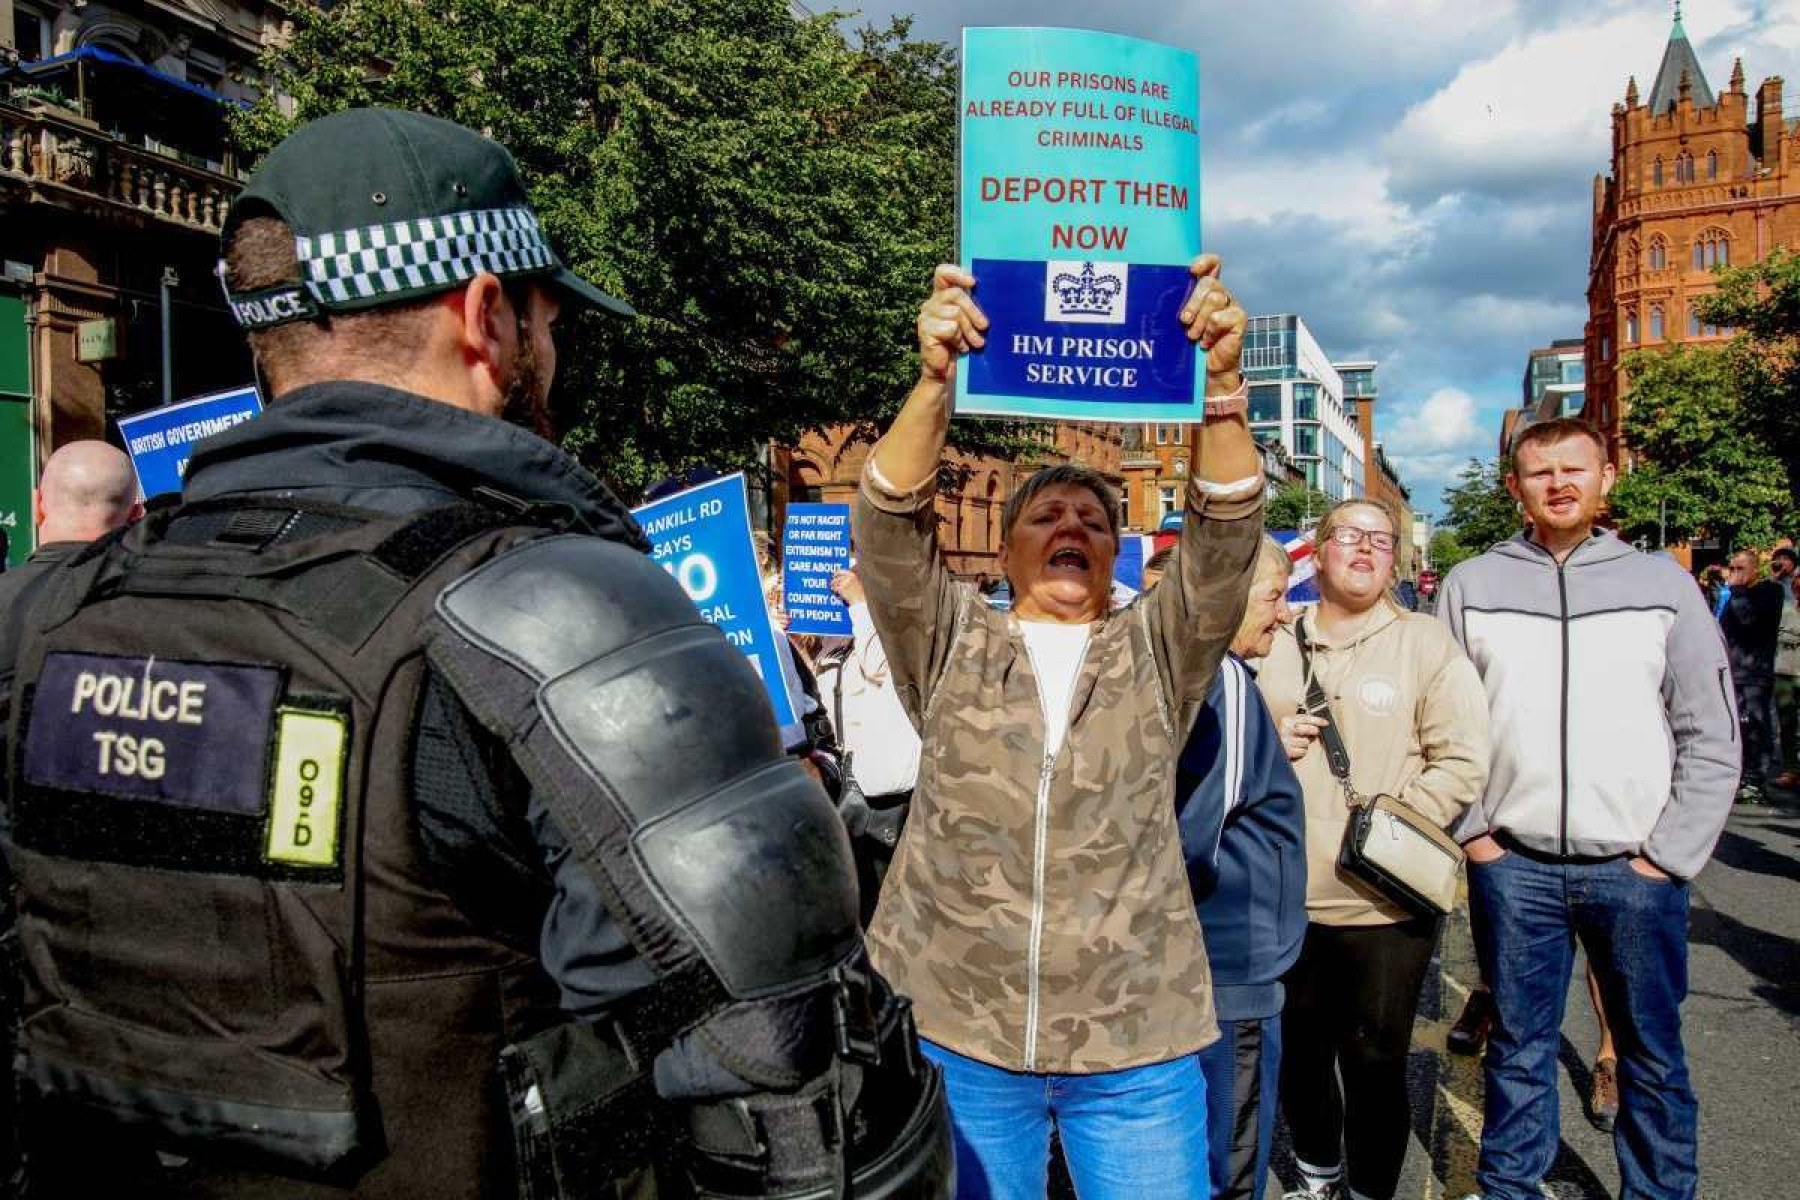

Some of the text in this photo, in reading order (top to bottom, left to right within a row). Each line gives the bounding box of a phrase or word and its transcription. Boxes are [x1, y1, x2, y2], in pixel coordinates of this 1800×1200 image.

[1008, 71, 1169, 99] OUR PRISONS ARE
[965, 100, 1199, 135] ALREADY FULL OF ILLEGAL
[1037, 131, 1144, 151] CRIMINALS
[980, 177, 1189, 211] DEPORT THEM
[1051, 224, 1129, 250] NOW
[232, 291, 308, 325] POLICE
[1012, 335, 1155, 360] HM PRISON
[1026, 362, 1138, 388] SERVICE
[130, 432, 166, 456] BRITISH
[642, 498, 722, 537] ANKILL RD
[800, 515, 817, 526] NOT
[817, 515, 847, 526] RACIST
[653, 535, 692, 559] SAYS
[788, 530, 843, 541] OR FAR RIGHT
[785, 545, 847, 557] EXTREMISM TO
[788, 561, 842, 573] CARE ABOUT
[802, 578, 828, 589] YOUR
[788, 592, 829, 605] COUNTRY
[806, 609, 843, 622] PEOPLE
[71, 671, 207, 725] POLICE
[92, 730, 166, 780] TSG
